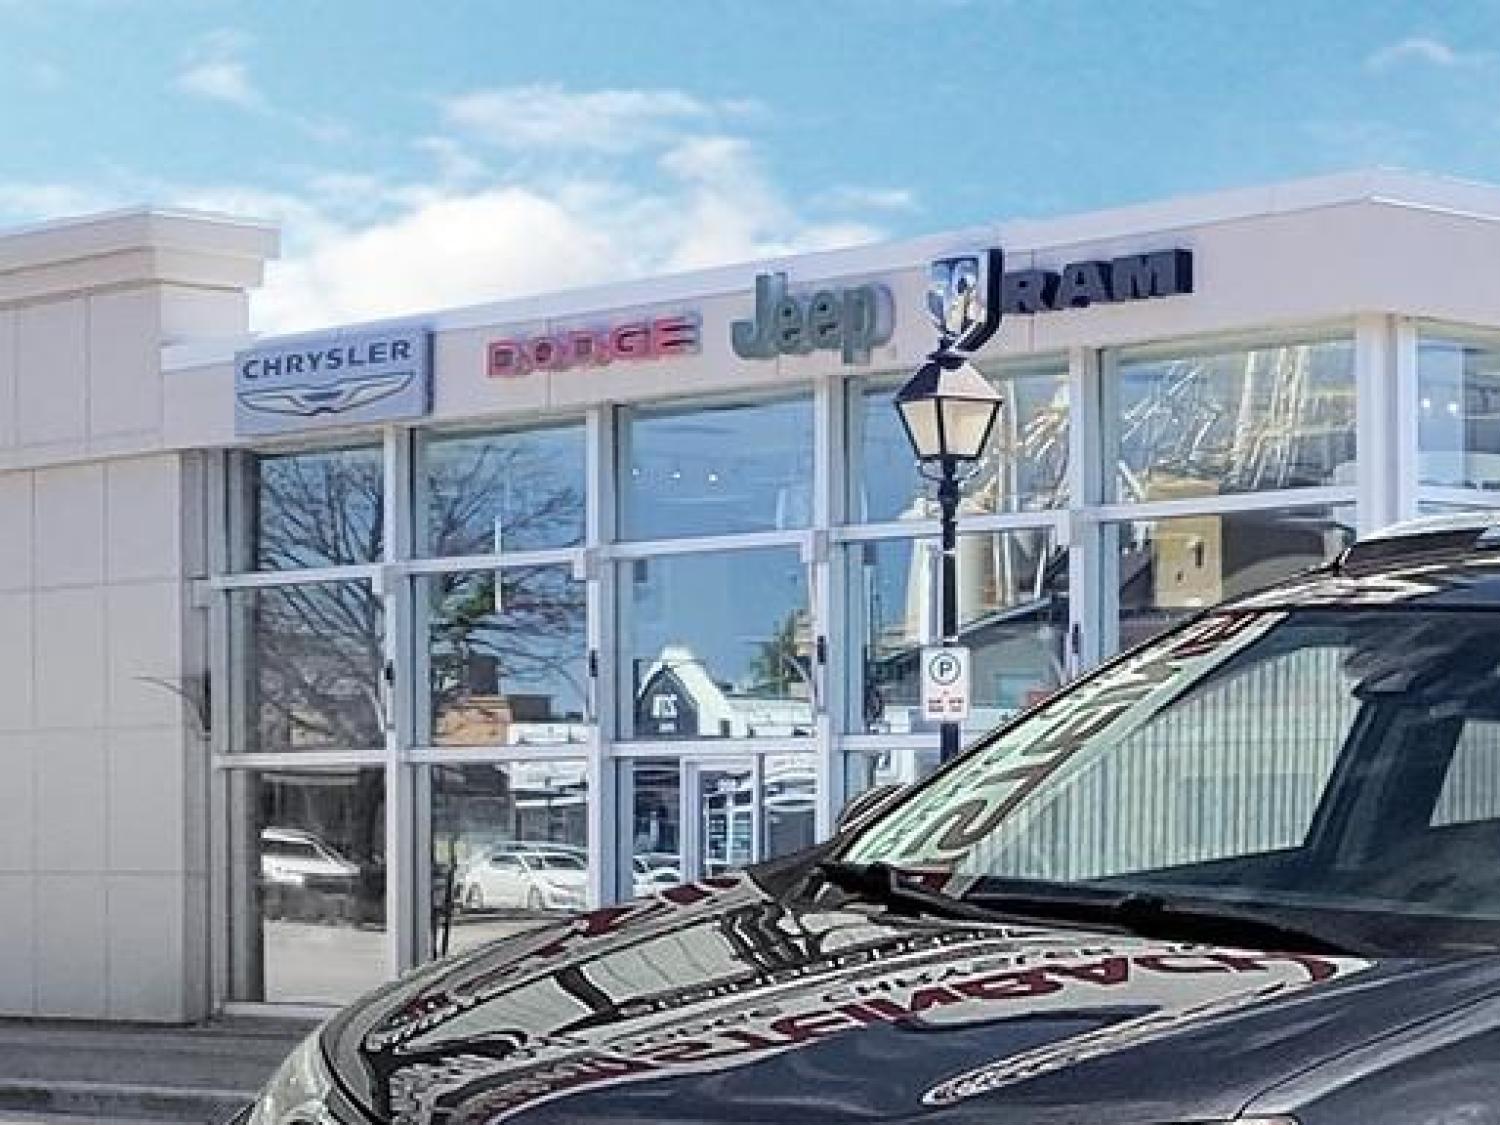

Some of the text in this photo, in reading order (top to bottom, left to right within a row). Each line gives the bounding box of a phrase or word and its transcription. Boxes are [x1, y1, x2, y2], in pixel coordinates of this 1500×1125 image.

[1001, 248, 1194, 316] RAM
[486, 316, 699, 378] DODGE
[731, 270, 895, 364] Jeep
[242, 338, 412, 380] CHRYSLER
[939, 660, 954, 678] P
